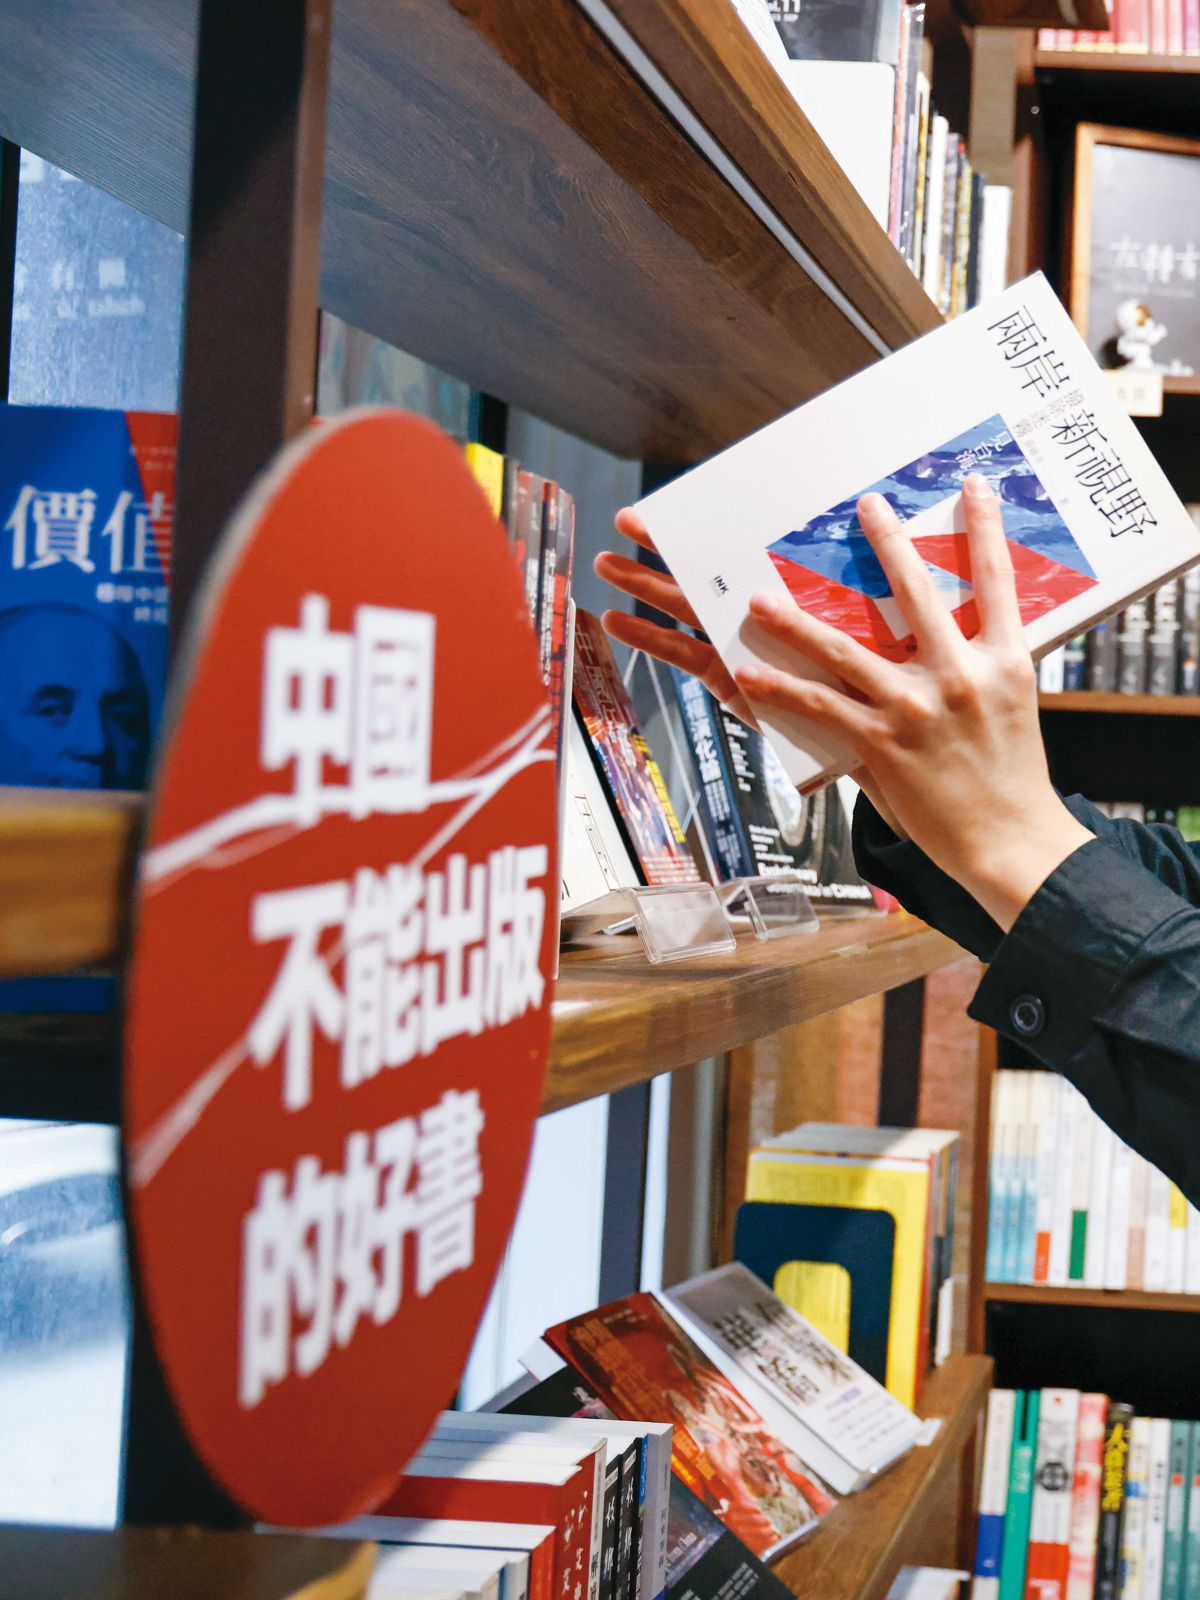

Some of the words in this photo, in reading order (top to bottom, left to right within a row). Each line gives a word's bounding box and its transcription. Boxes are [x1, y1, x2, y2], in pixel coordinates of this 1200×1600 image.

[987, 305, 1157, 537] 兩岸新視野
[714, 575, 729, 594] INK
[260, 592, 437, 828] 中國
[249, 844, 548, 1112] 不能出版
[237, 1088, 485, 1409] 的好書
